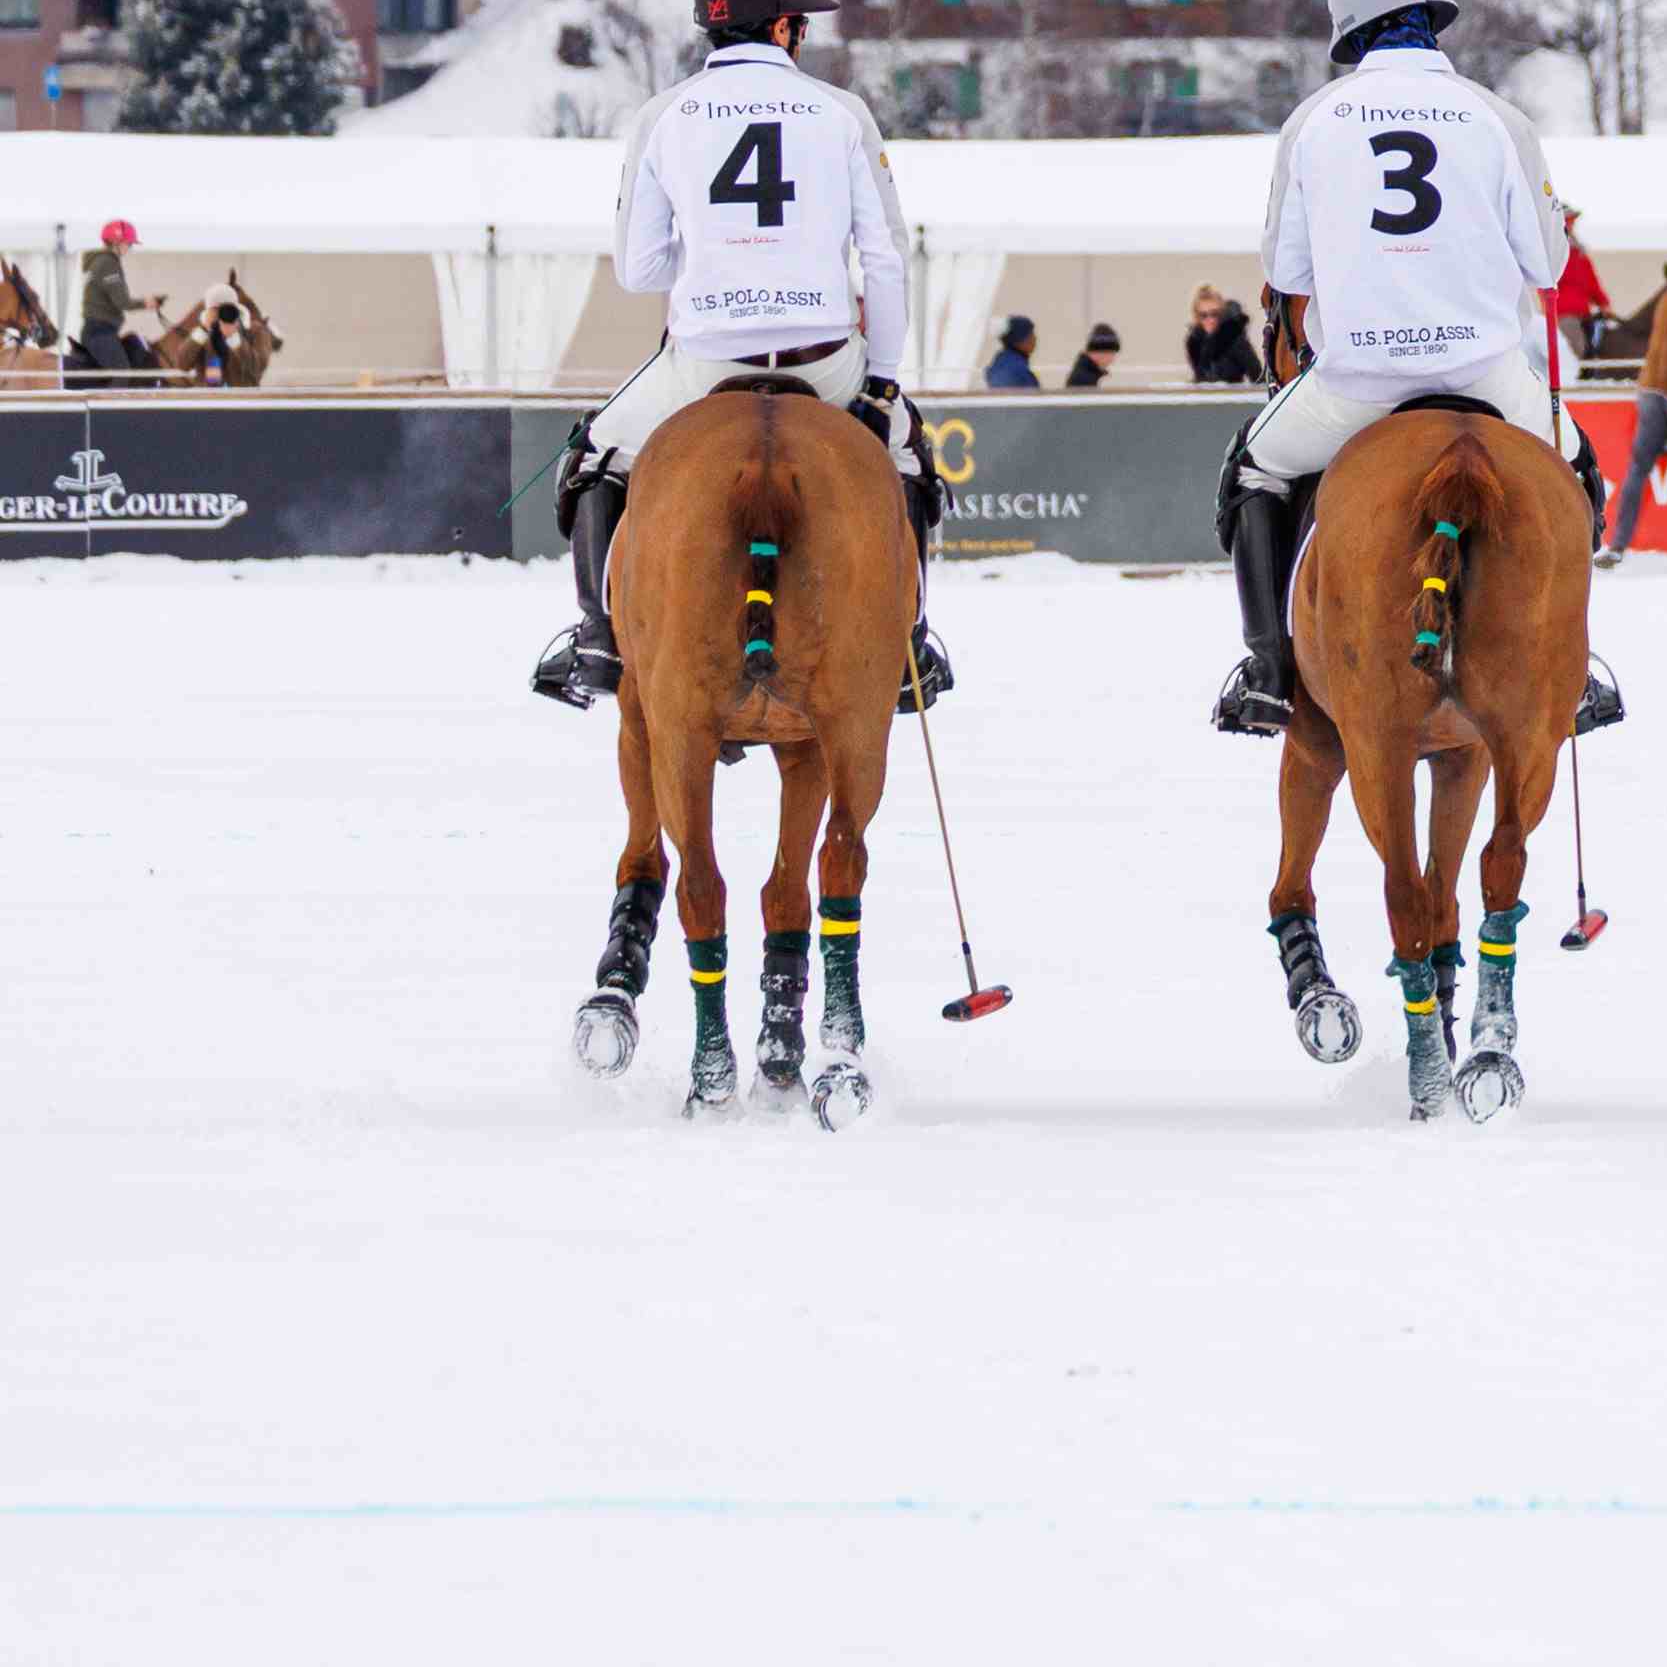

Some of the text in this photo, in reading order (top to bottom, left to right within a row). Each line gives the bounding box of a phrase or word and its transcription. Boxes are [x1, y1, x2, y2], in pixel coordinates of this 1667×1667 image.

[706, 100, 824, 120] Investec
[1359, 103, 1474, 124] Investec
[708, 121, 796, 228] 4
[1368, 130, 1443, 236] 3
[723, 289, 771, 308] POLO
[774, 290, 827, 308] ASSN.
[1350, 325, 1481, 347] U.S. POLO ASSN.
[1387, 342, 1449, 358] SINCE 1890
